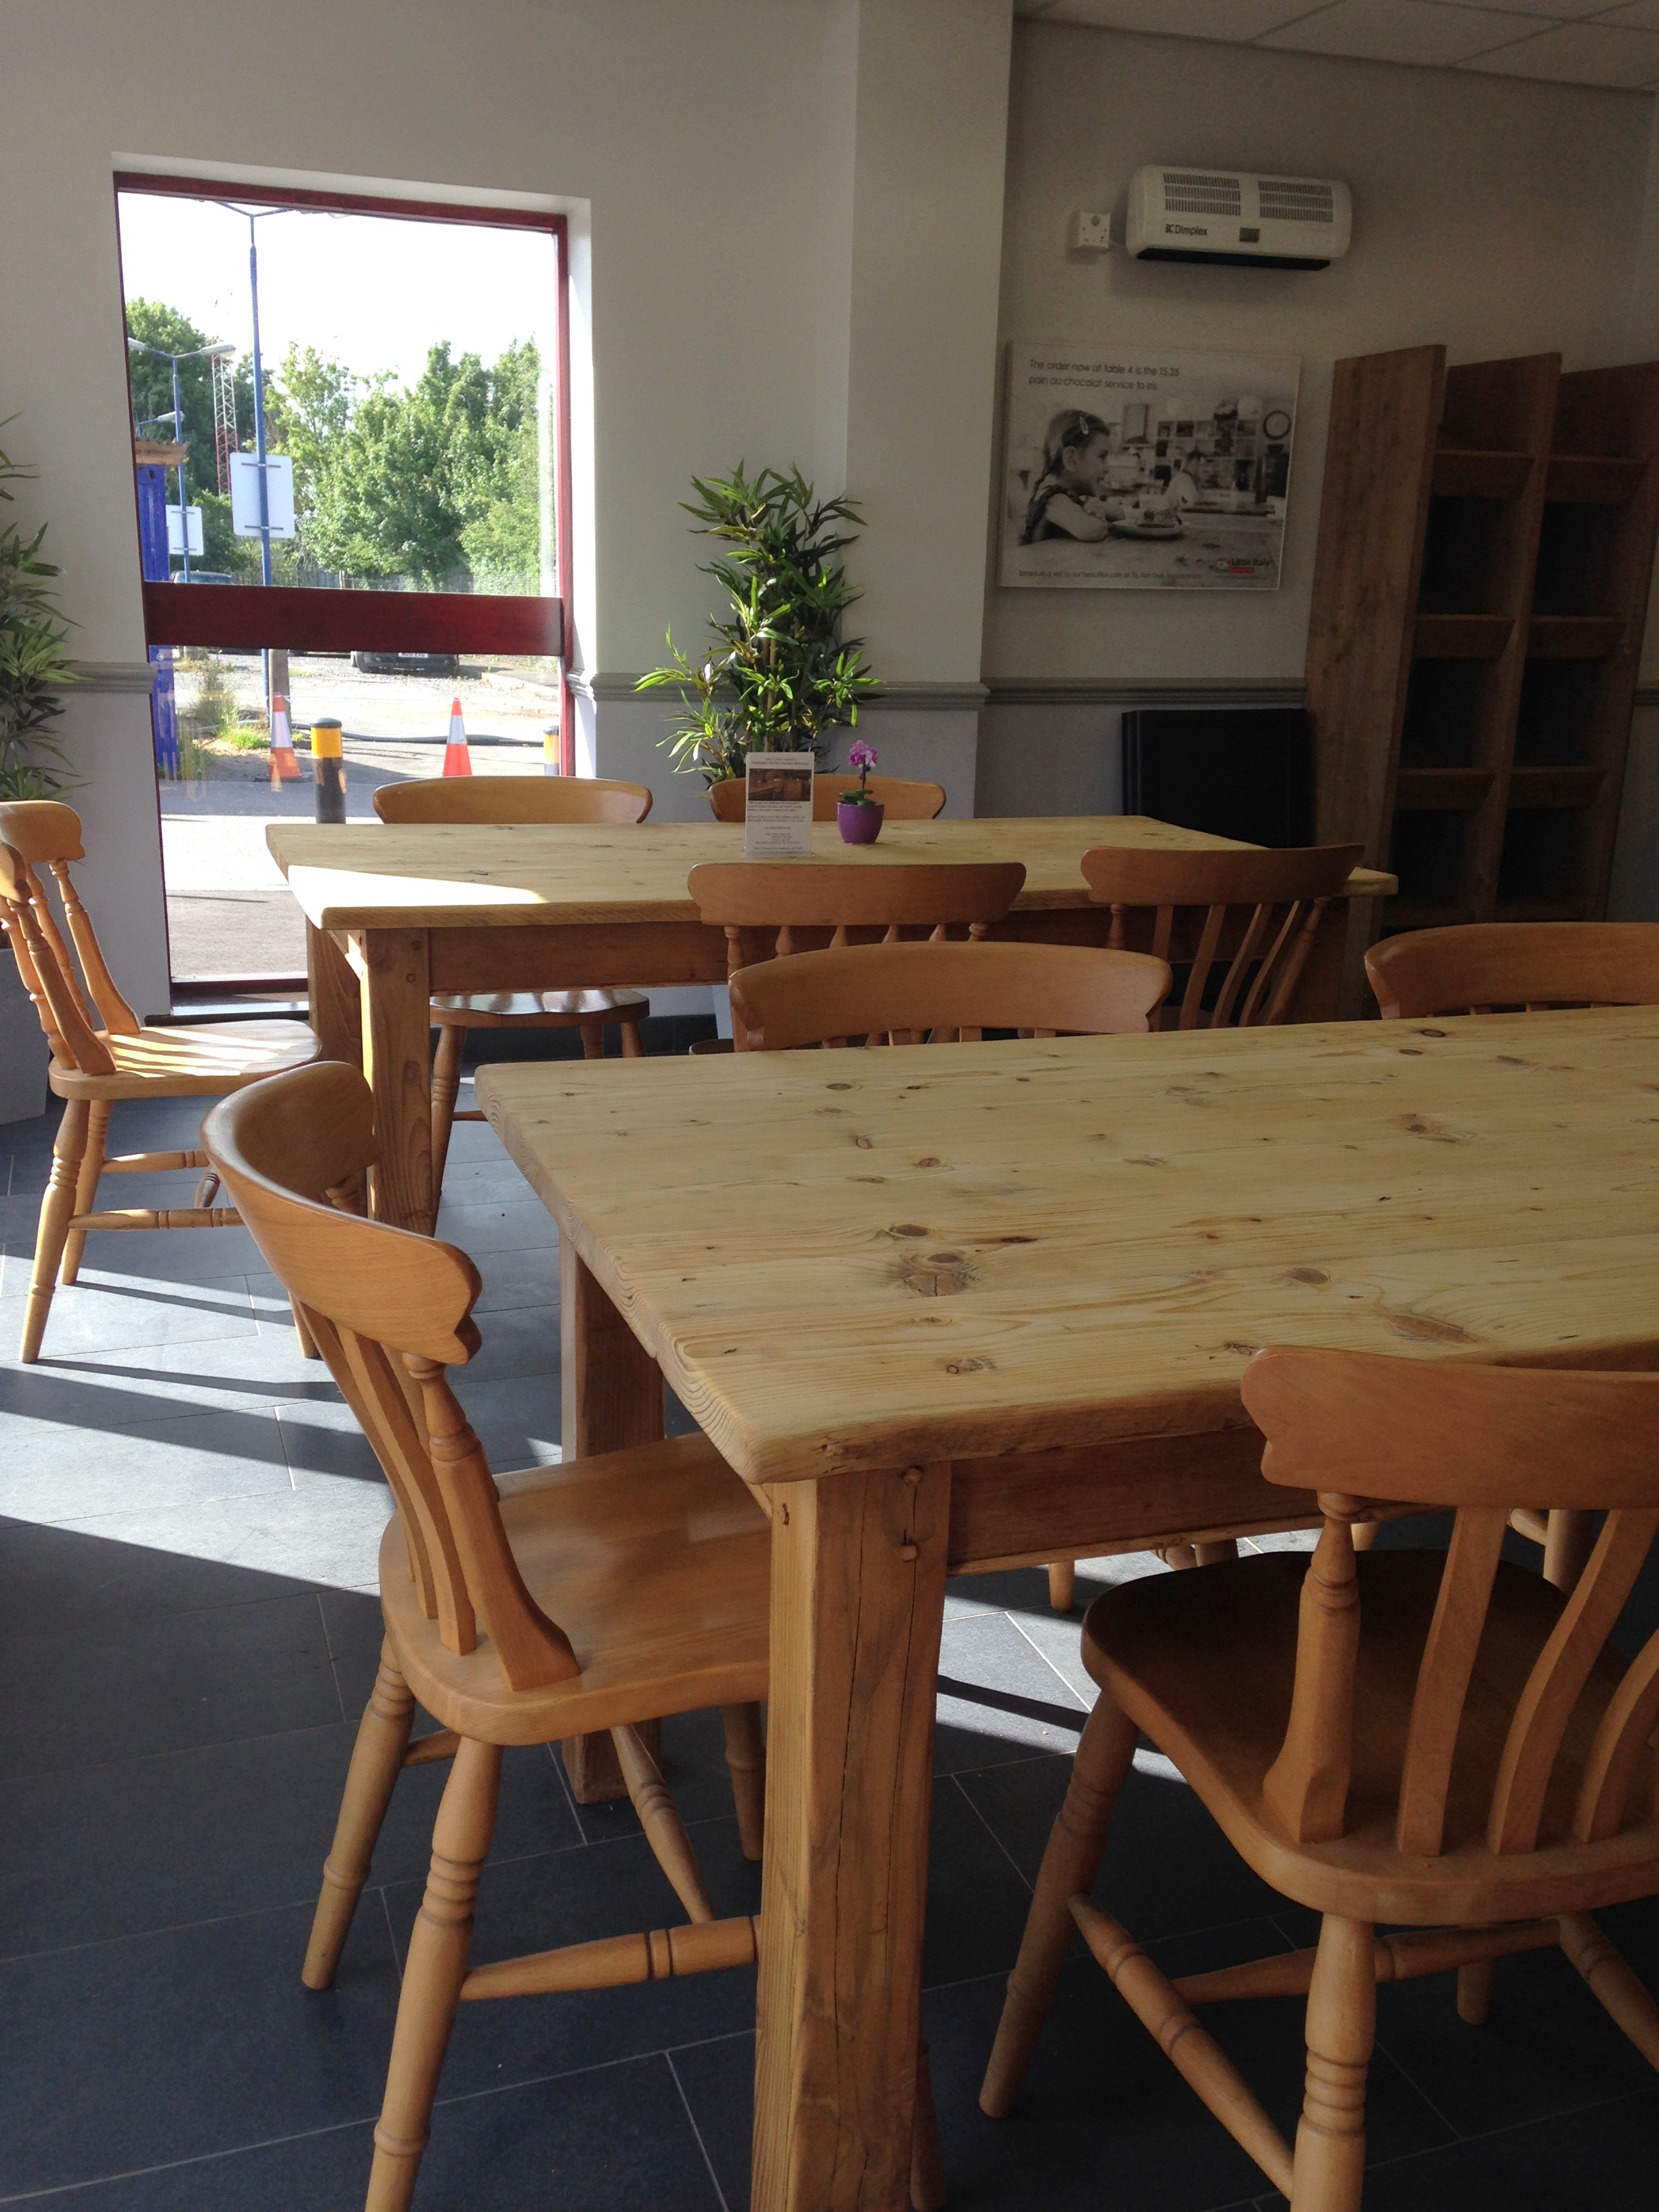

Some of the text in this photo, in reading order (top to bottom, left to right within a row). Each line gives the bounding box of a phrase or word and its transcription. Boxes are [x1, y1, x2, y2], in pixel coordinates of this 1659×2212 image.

[1174, 224, 1208, 236] Dimplex
[1030, 359, 1044, 369] The
[1047, 362, 1070, 371] order
[1071, 363, 1090, 371] now
[1092, 363, 1101, 372] at
[1104, 364, 1126, 374] table
[1128, 366, 1132, 374] 4
[1135, 365, 1141, 375] is
[1143, 367, 1158, 375] the
[1029, 375, 1048, 385] pain
[1050, 377, 1062, 385] au
[1063, 377, 1102, 388] chocolat
[1104, 380, 1134, 389] service
[1136, 381, 1145, 390] to
[1231, 558, 1271, 568] Little Italy
